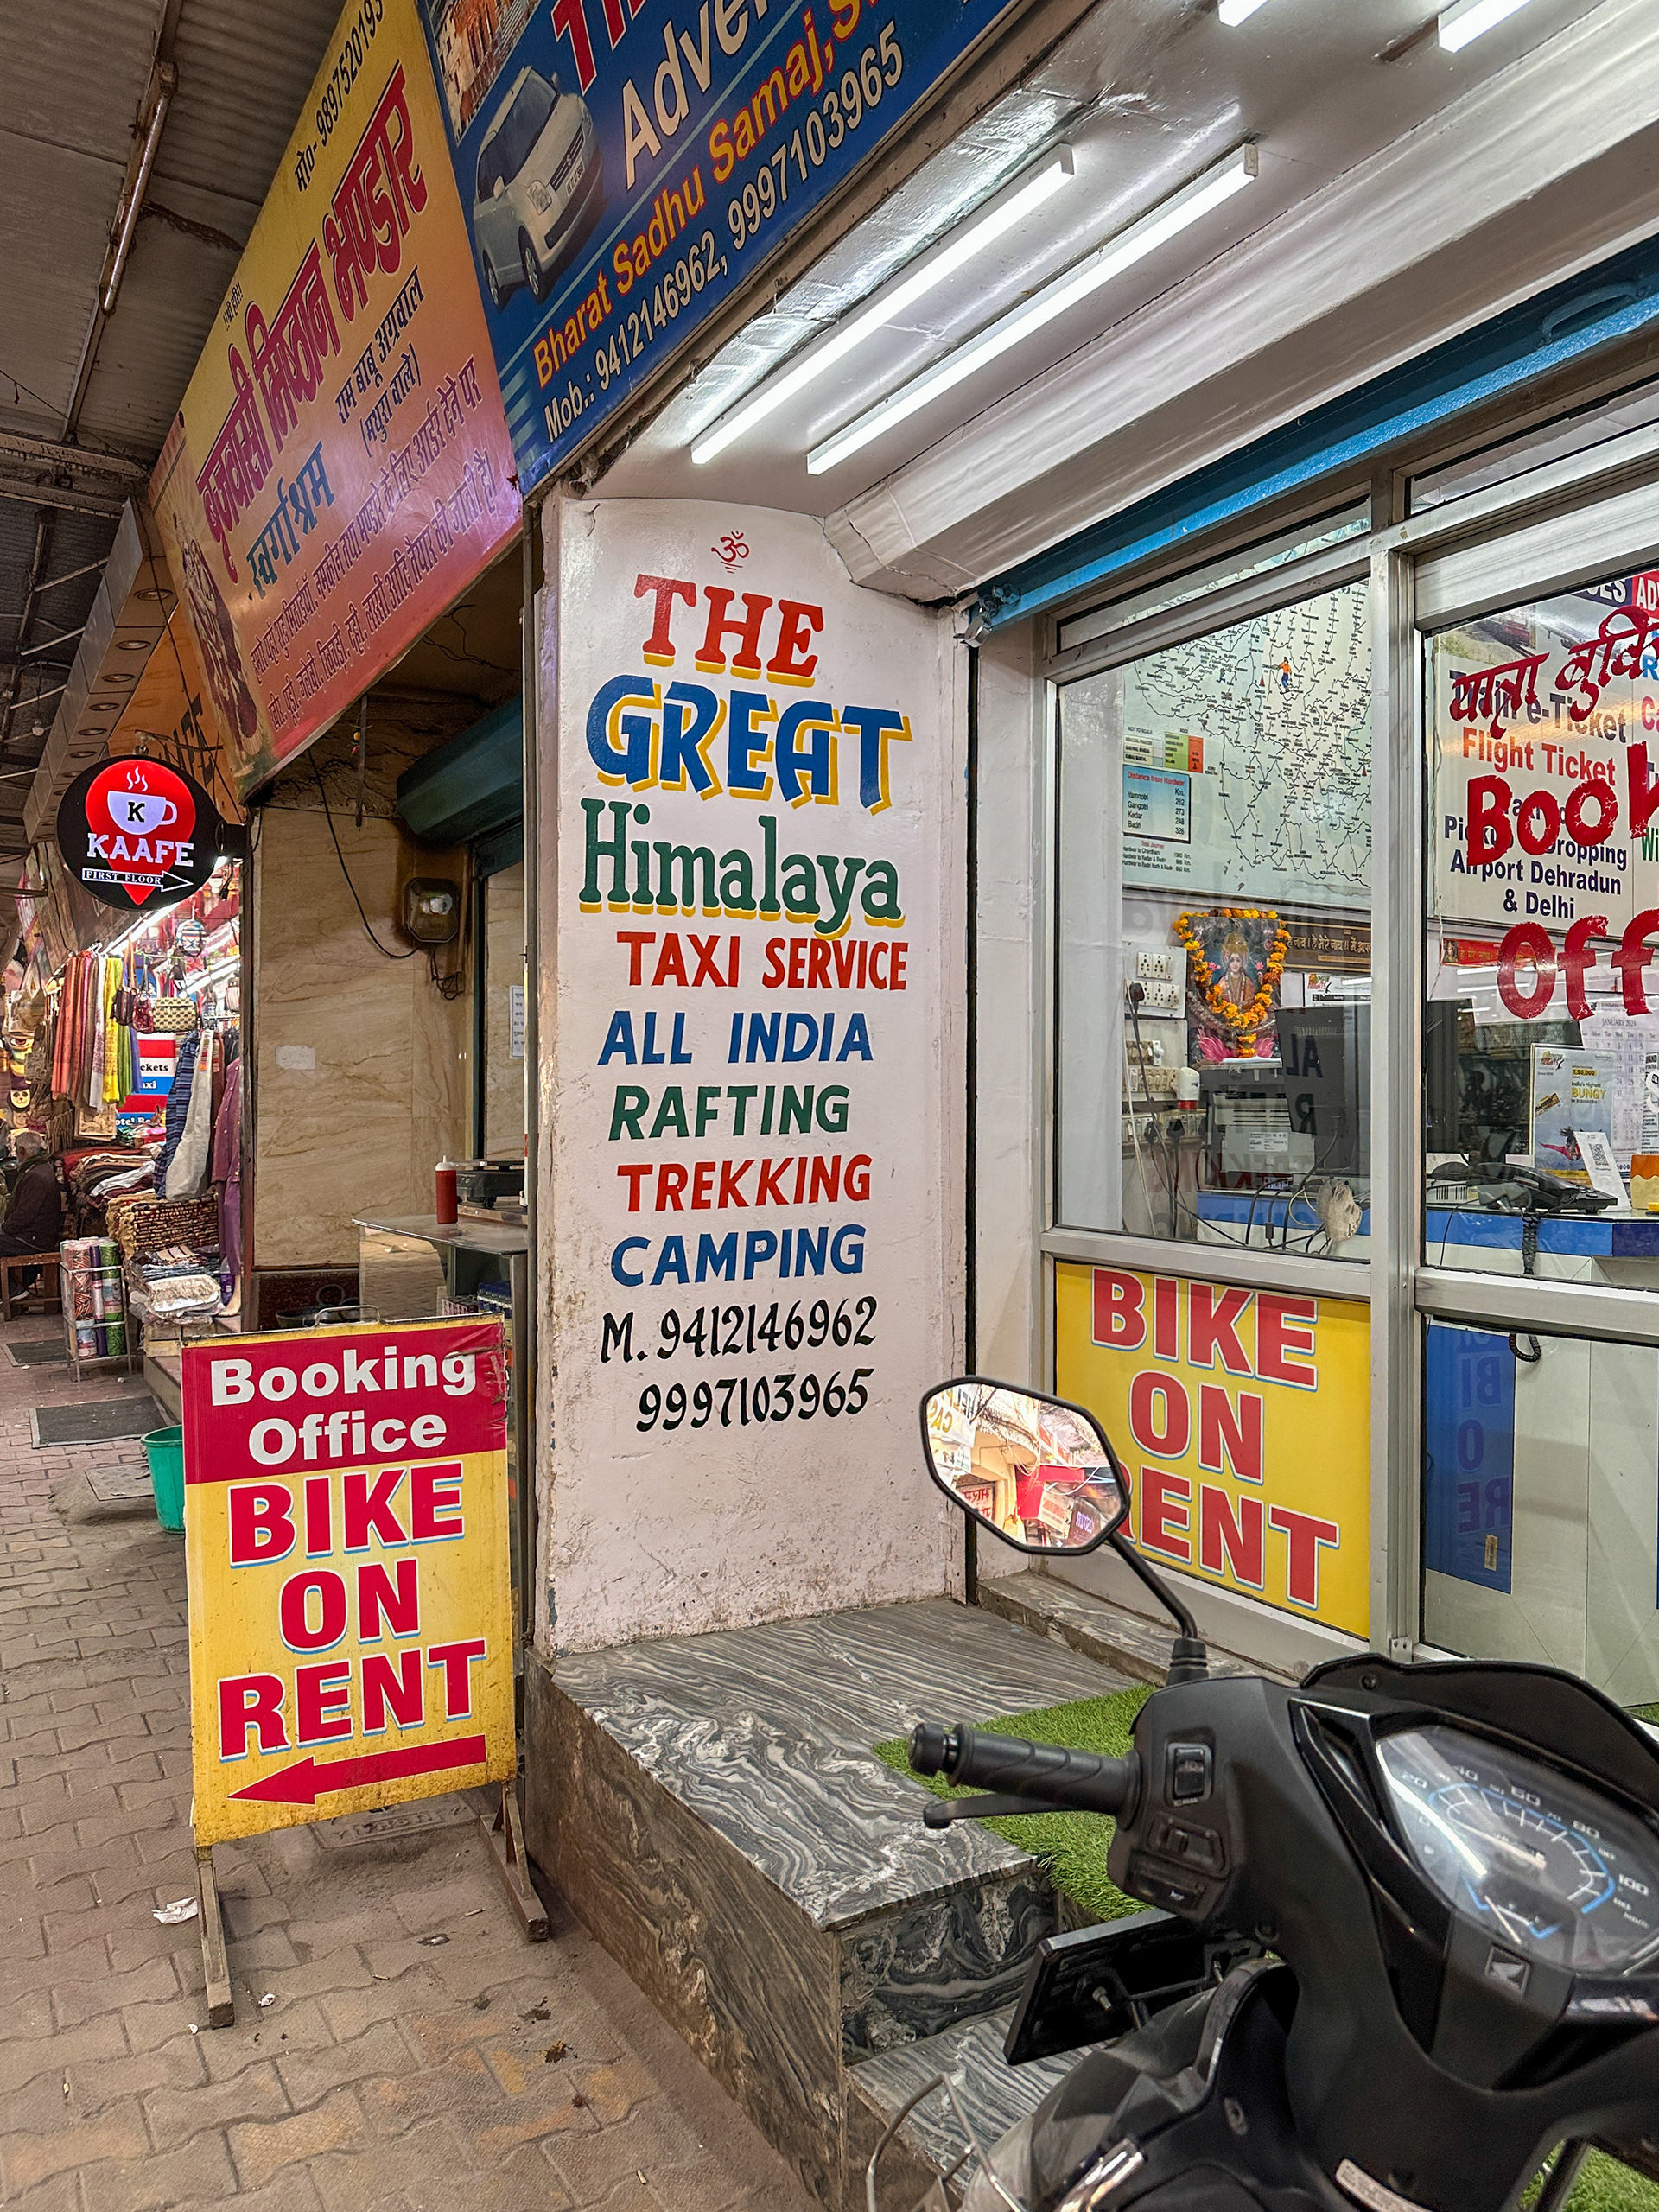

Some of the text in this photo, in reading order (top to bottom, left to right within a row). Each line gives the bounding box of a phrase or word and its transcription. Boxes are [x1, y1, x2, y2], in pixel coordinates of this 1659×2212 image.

[623, 0, 767, 189] Adve
[322, 59, 428, 323] भण्डार
[544, 20, 902, 442] Mob.: 9412146962, 9997103965
[533, 166, 705, 389] Bharat Sadhu
[335, 265, 423, 424] राम बाबू अग्रवाल
[313, 542, 346, 601] नमकीन
[340, 521, 362, 570] तथा
[380, 467, 394, 512] के
[389, 443, 418, 501] लिए
[437, 374, 464, 436] देने
[459, 354, 482, 409] पर
[246, 441, 335, 599] स्वर्गाश्रम
[385, 549, 414, 610] आदि
[404, 535, 439, 585] तैयार
[431, 498, 454, 555] की
[448, 461, 483, 535] जाती
[1636, 577, 1659, 611] AD
[633, 574, 825, 687] THE
[1449, 670, 1517, 720] Tain
[585, 675, 913, 816] GREAT
[1463, 727, 1534, 773] Flight
[1541, 743, 1615, 786] Ticket
[1128, 771, 1150, 781] Distance
[1151, 774, 1162, 783] from
[1128, 791, 1149, 800] Yamnotri
[1128, 802, 1148, 810] Gangotri
[128, 800, 145, 823] K
[86, 871, 162, 885] FIRST FLOOR
[87, 833, 194, 867] KAAFE
[579, 798, 905, 939] Himalaya
[1531, 861, 1621, 894] Dehradun
[1547, 838, 1626, 871] ropping
[1503, 889, 1574, 919] & Delhi
[616, 931, 908, 991] TAXI SERVICE
[596, 1010, 874, 1065] ALL INDIA
[608, 1084, 851, 1141] RAFTING
[1572, 1087, 1607, 1099] BUNGY
[617, 1154, 874, 1212] TREKKING
[609, 1224, 867, 1287] CAMPING
[657, 1295, 878, 1361] 9412146962
[1091, 1266, 1319, 1391] BIKE
[210, 1345, 476, 1408] Booking
[635, 1368, 874, 1433] 9997103965
[248, 1411, 448, 1465] Office
[1129, 1369, 1264, 1485] ON
[227, 1459, 466, 1568] BIKE
[1119, 1461, 1340, 1611] ENT
[279, 1556, 422, 1655] ON
[218, 1637, 487, 1764] RENT
[1511, 1786, 1541, 1806] 60
[1573, 1821, 1599, 1839] 80
[1619, 1874, 1649, 1897] 100
